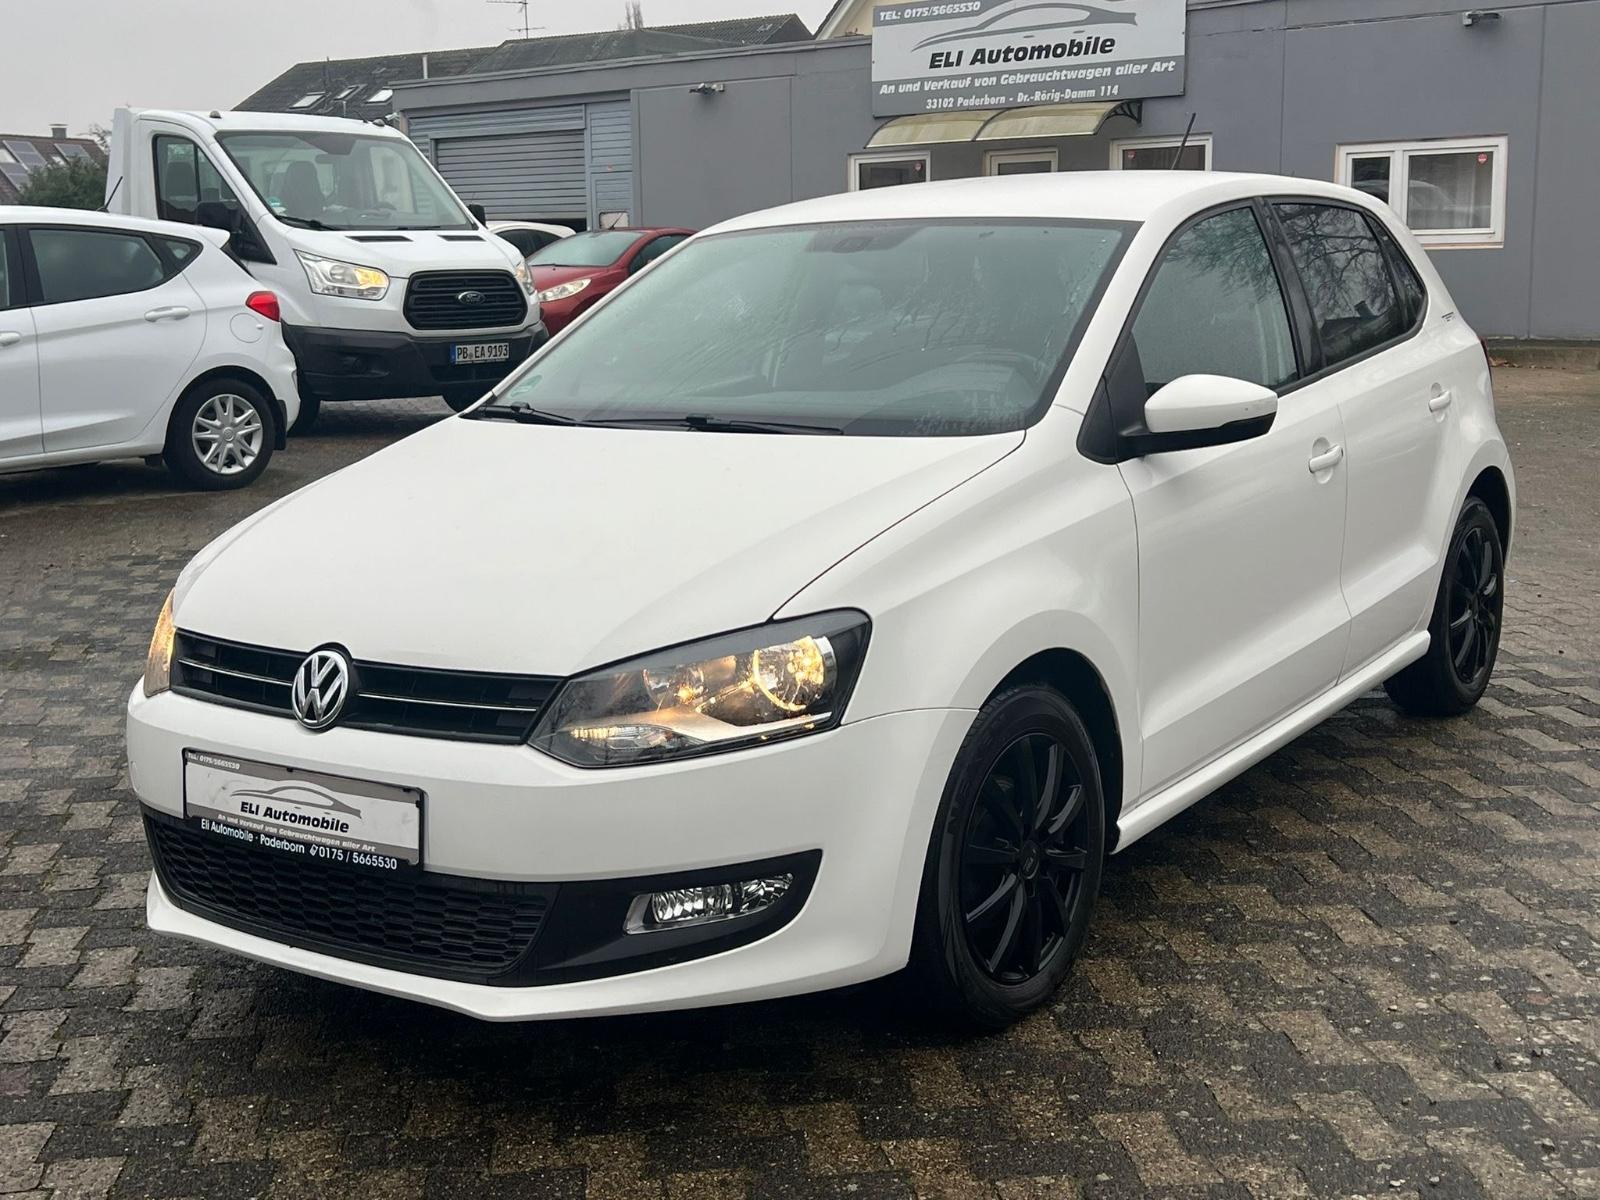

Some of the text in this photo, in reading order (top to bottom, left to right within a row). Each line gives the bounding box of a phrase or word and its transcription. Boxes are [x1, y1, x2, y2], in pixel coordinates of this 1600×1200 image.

[880, 1, 981, 21] TEL: 0175/5665530
[929, 36, 1116, 69] ELI Automobile
[880, 60, 1176, 94] An und Verkauf von Gebrauchtwagen aller Art
[926, 97, 954, 109] 33102
[957, 94, 1006, 107] Paderborn
[1017, 88, 1096, 104] Dr.-Rörig-Damm
[1100, 85, 1119, 97] 114
[457, 344, 508, 360] PB EA 9193
[218, 813, 376, 852] An und Verkauf von Gebrauchtwagen aller Art
[241, 801, 350, 833] ELI Automobile
[201, 818, 210, 830] Eli
[210, 820, 254, 842] Automobile
[260, 833, 305, 854] Paderborn
[319, 846, 344, 861] 0175
[352, 852, 398, 870] 5665530
